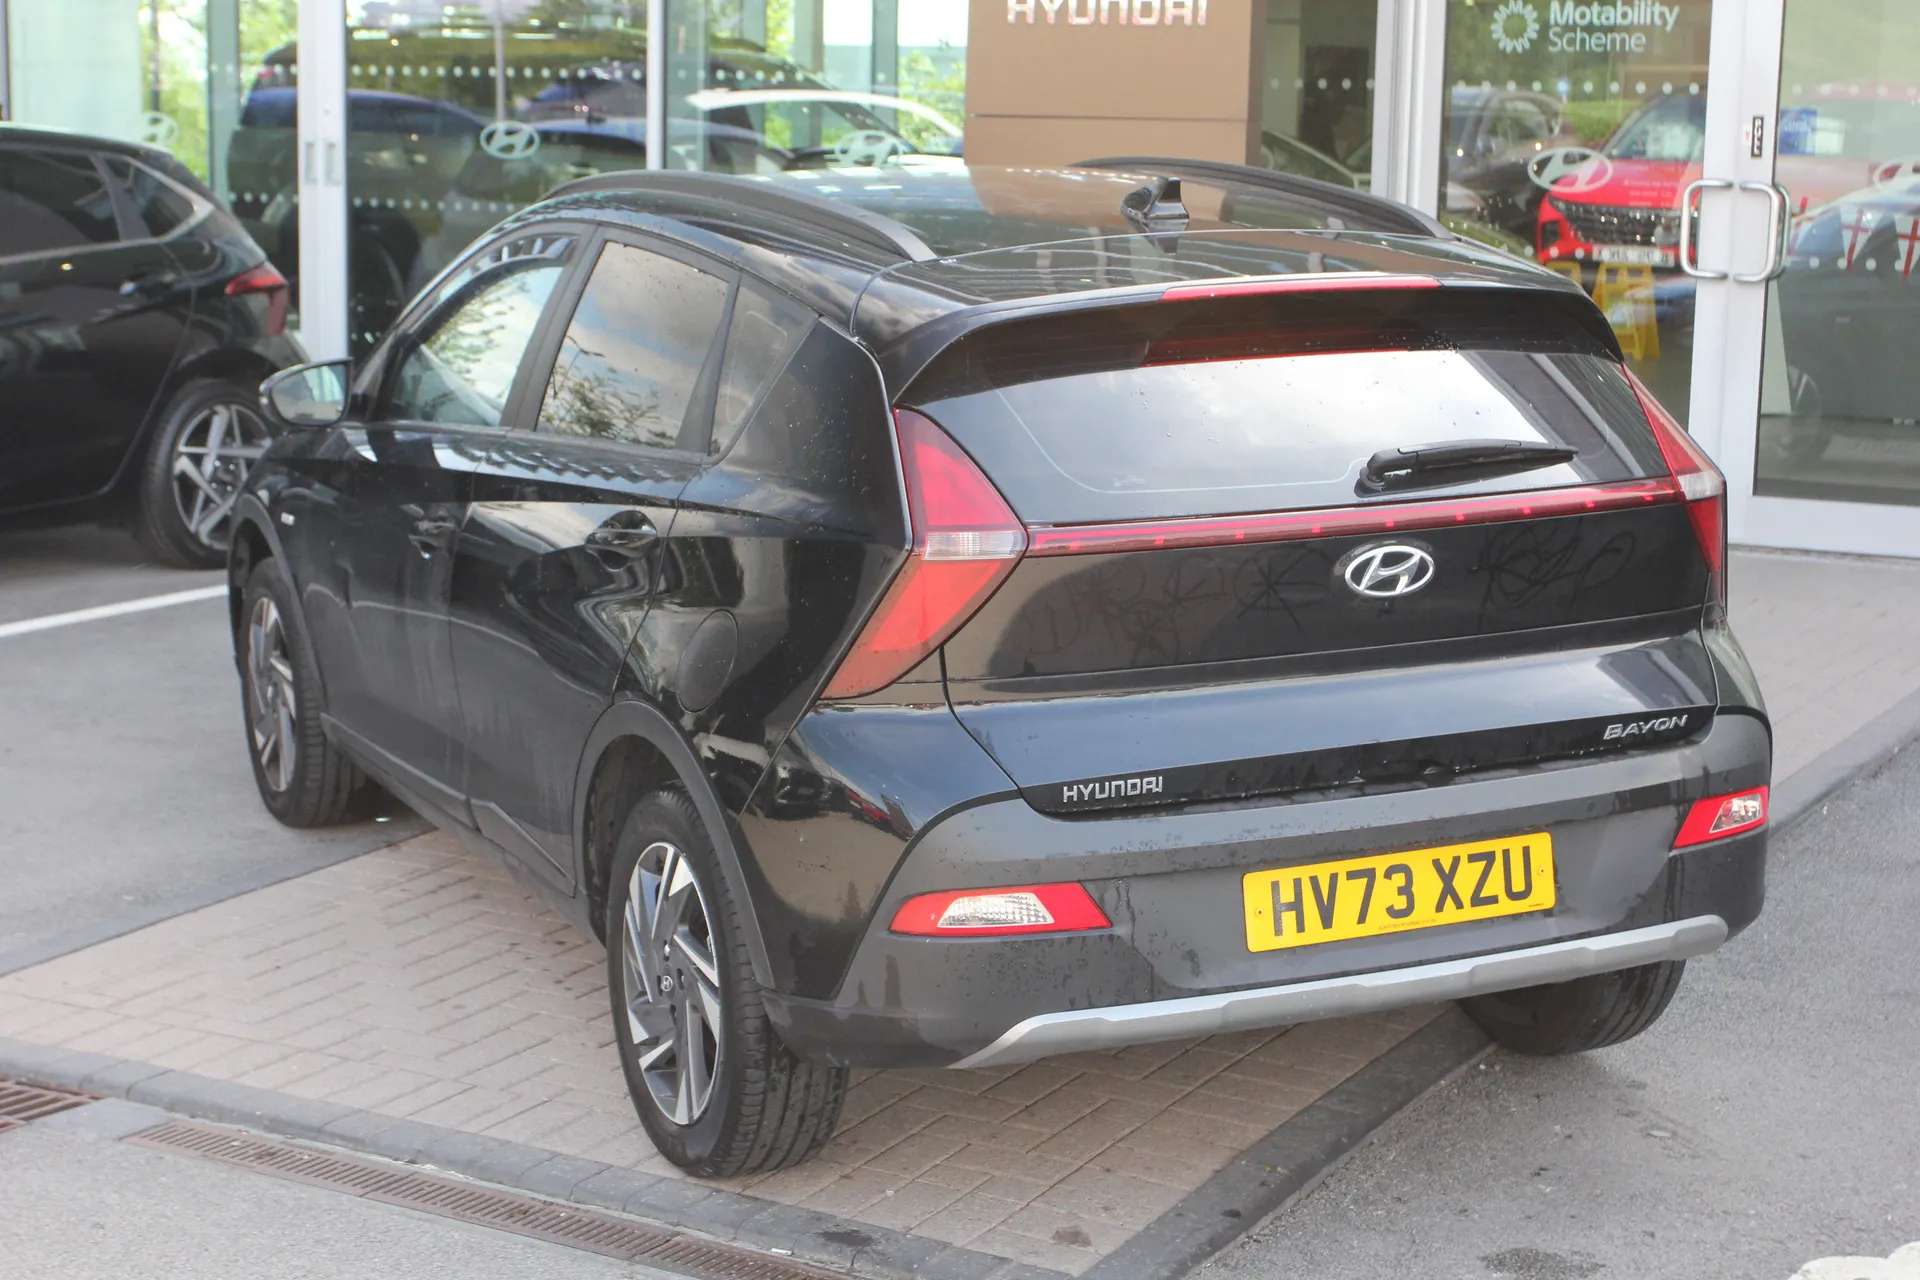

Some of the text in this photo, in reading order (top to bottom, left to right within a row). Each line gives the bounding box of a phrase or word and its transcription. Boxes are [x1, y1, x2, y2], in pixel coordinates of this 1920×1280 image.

[1007, 0, 1206, 25] HYUNDAI
[1550, 0, 1680, 32] Motability
[1548, 27, 1647, 51] Scheme
[1603, 715, 1688, 740] BAYON
[1063, 776, 1163, 802] HYUNDAI
[1270, 845, 1533, 936] HV73 XZU
